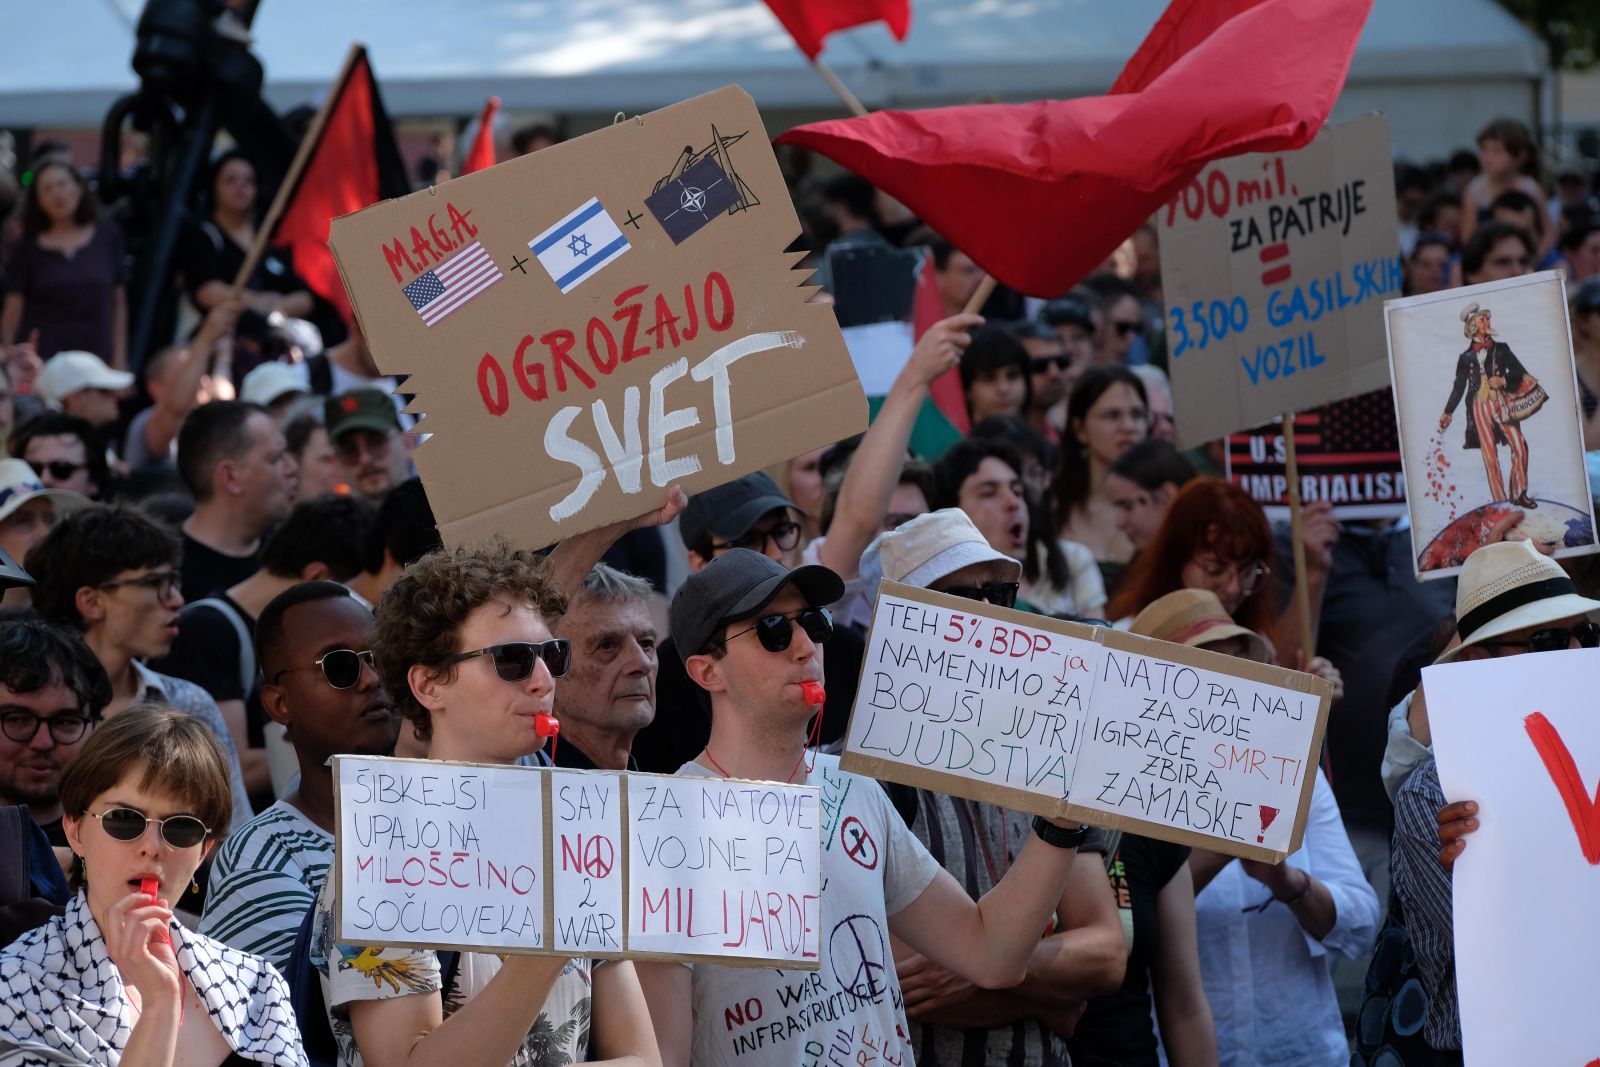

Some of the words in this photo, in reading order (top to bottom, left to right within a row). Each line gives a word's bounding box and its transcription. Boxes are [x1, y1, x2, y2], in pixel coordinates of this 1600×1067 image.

[1230, 216, 1263, 252] ZA
[1268, 180, 1367, 242] PATRIJE
[1170, 296, 1249, 358] 3.500
[1267, 255, 1402, 327] GASILSKIH
[477, 271, 735, 416] OGROŽAJO
[1240, 331, 1326, 385] VOZIL
[544, 331, 806, 523] SVET
[1241, 473, 1405, 503] IMPRIALIS
[885, 602, 938, 636] TEH
[943, 614, 983, 648] 5%
[879, 638, 1043, 697] NAMENIMO
[1048, 681, 1082, 711] ZA
[1103, 652, 1200, 700] NATO
[1207, 683, 1240, 710] PA
[1252, 692, 1303, 721] NAJ
[868, 671, 984, 727] BOLJŠI
[1000, 705, 1079, 754] JUTRI
[1139, 697, 1176, 724] ZA
[1184, 707, 1251, 742] SVOJE
[860, 711, 1070, 800] LJUDSTVA,
[1094, 716, 1196, 762] IGRAČE
[1208, 743, 1302, 787] SMRTI
[1140, 754, 1223, 792] ZBIRA
[353, 768, 486, 810] ŠIBKEJŠI
[559, 784, 609, 821] SAY
[637, 786, 683, 822] ZA
[702, 787, 813, 830] NATOVE
[354, 812, 440, 850] UPAJO
[448, 820, 481, 852] NA
[637, 832, 752, 872] VOJNE
[765, 836, 805, 875] PA
[356, 851, 536, 896] MILOŠČINO
[578, 877, 597, 908] 2
[352, 892, 541, 946] SOČLOVEKA,
[558, 913, 619, 948] WAR
[641, 886, 821, 958] MILIJARDE
[724, 997, 763, 1032] NO
[776, 972, 828, 1009] WAR
[732, 977, 884, 1056] INFRASTRUCTURE
